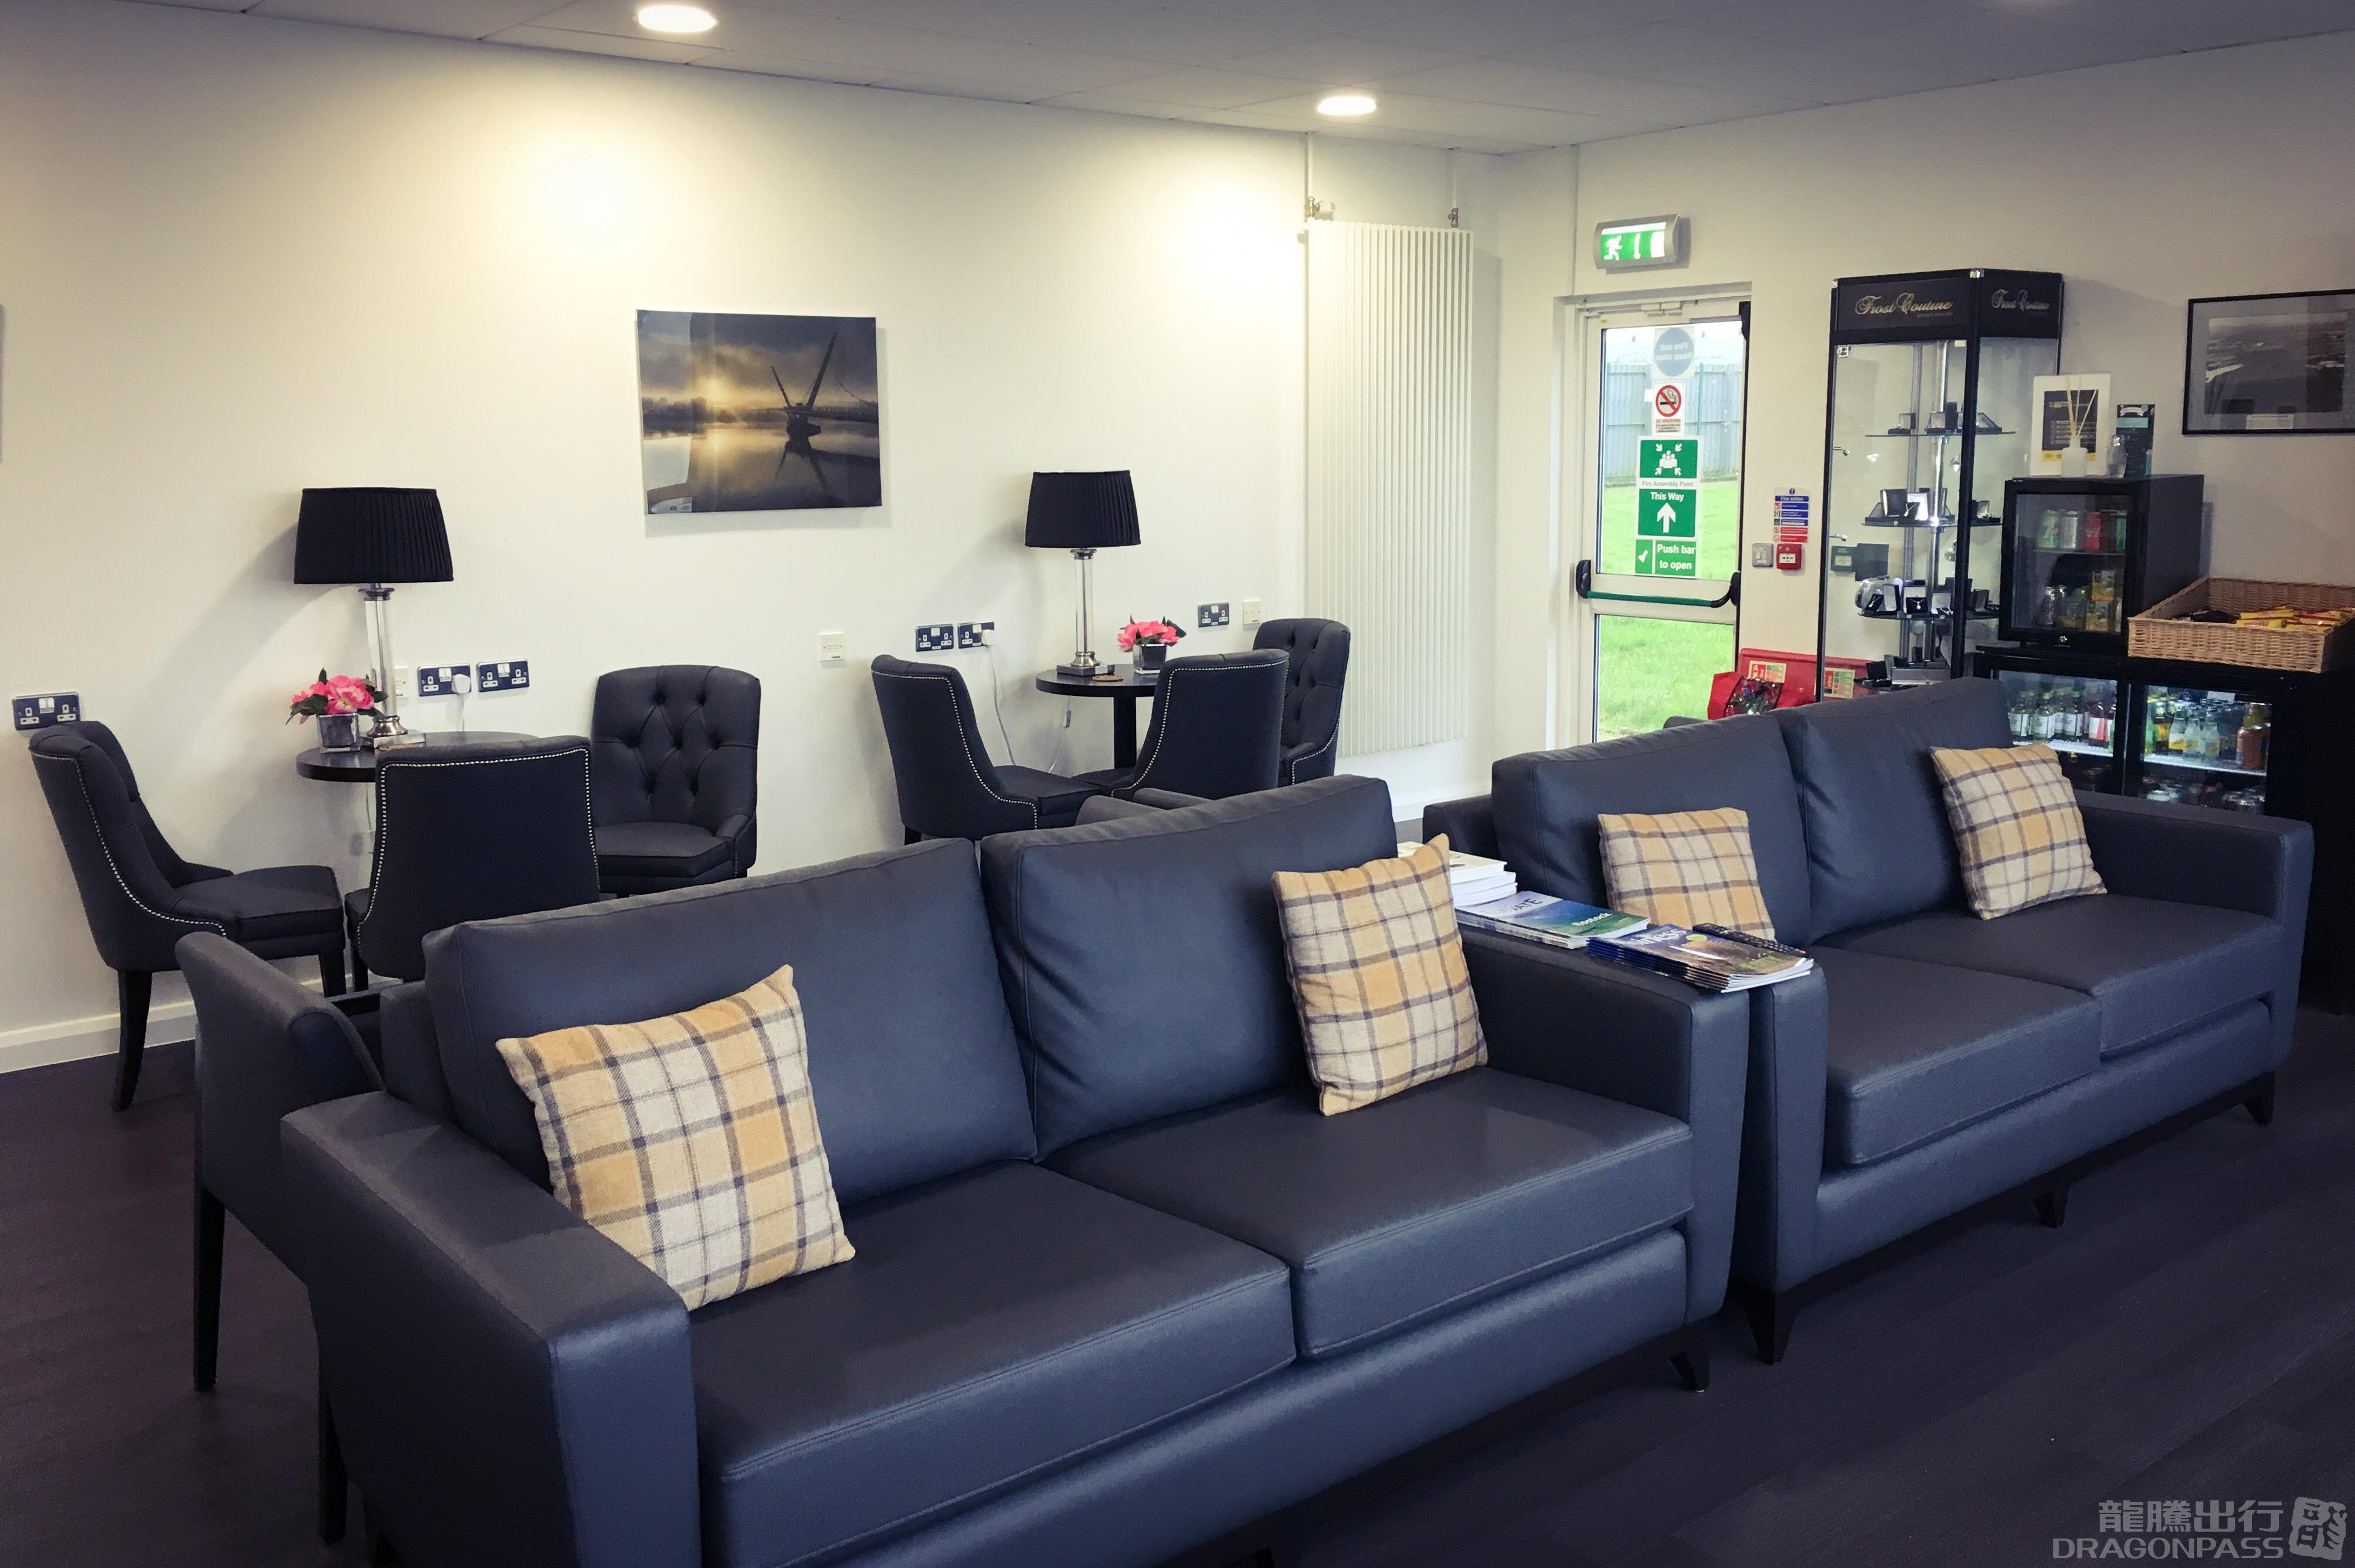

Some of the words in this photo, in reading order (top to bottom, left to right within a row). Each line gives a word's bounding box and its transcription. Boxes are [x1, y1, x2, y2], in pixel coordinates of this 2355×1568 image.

[1650, 492, 1666, 500] This
[1668, 492, 1685, 503] Way
[1657, 544, 1679, 554] Push
[1681, 544, 1696, 554] bar
[1659, 560, 1669, 569] to
[1670, 561, 1692, 571] open
